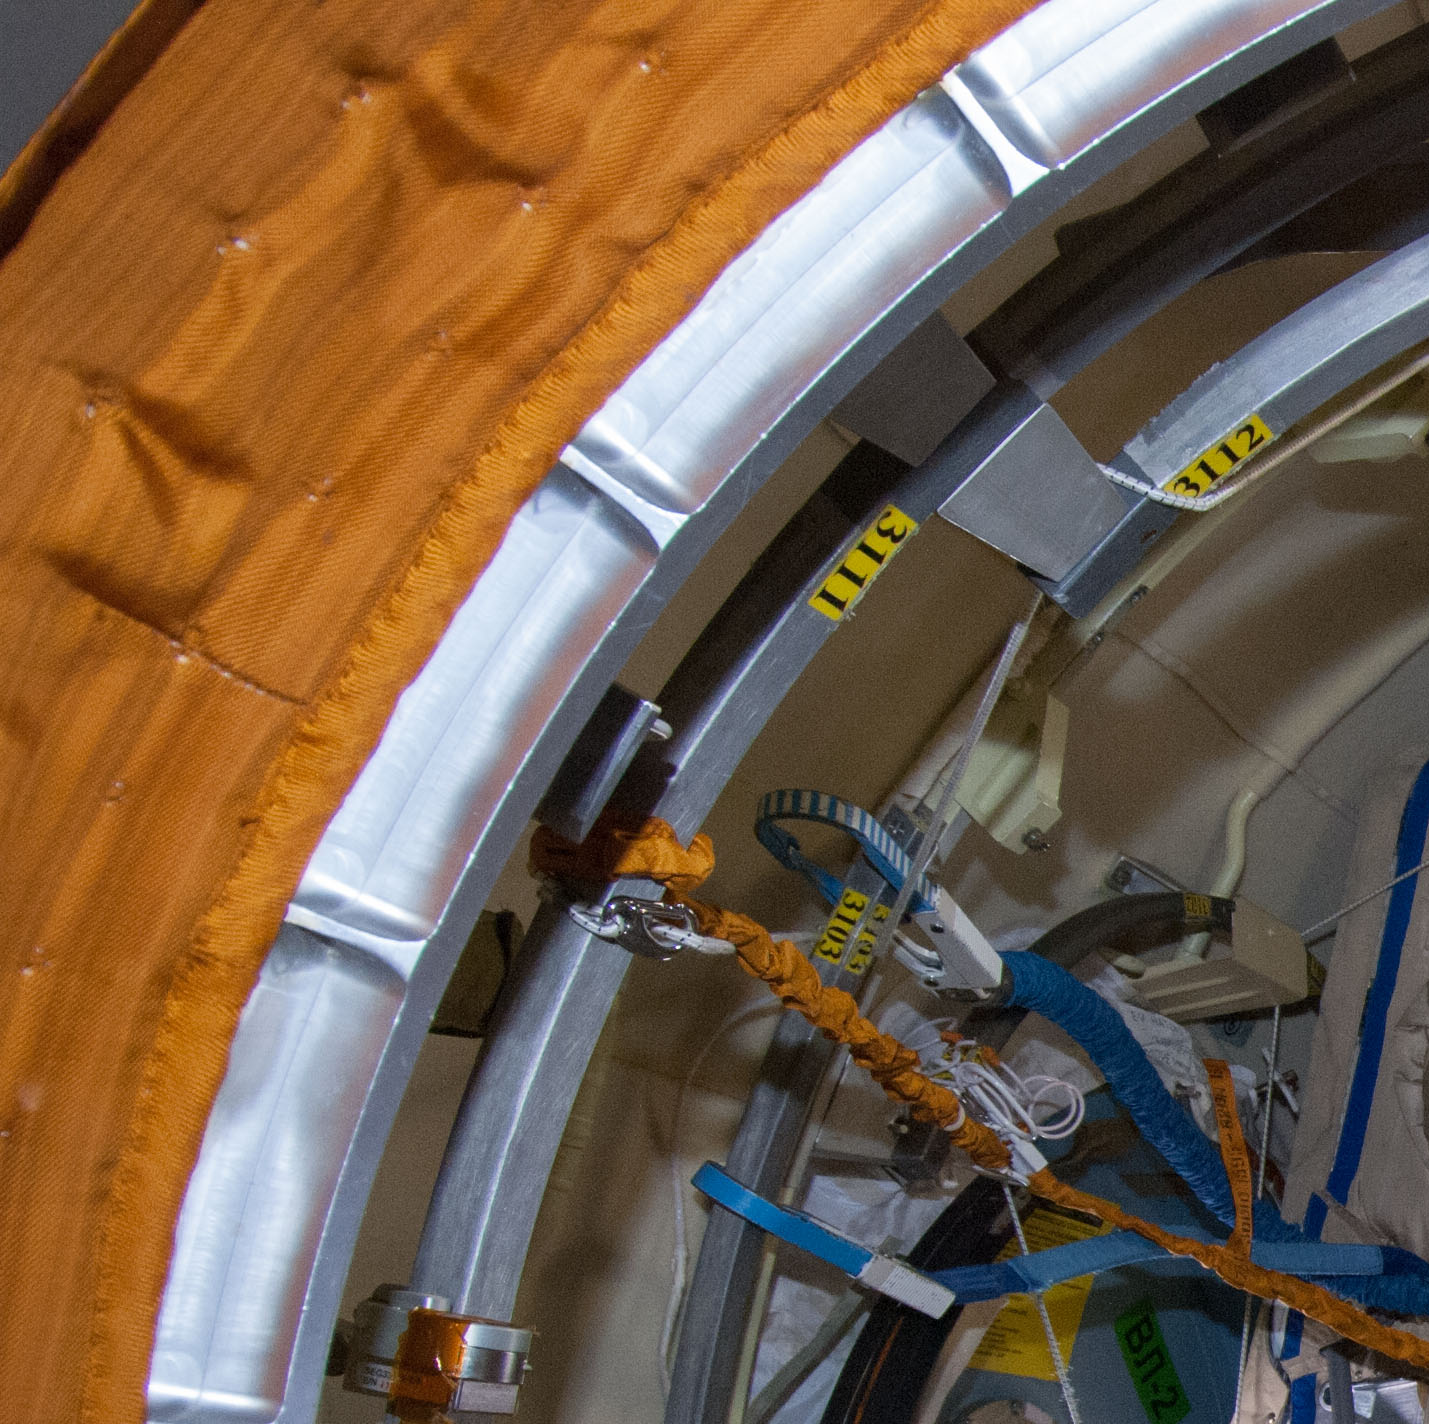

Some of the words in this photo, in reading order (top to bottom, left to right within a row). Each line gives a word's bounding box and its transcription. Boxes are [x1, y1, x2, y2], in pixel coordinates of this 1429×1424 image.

[1174, 424, 1264, 498] 3112
[814, 510, 908, 613] 3111
[821, 892, 865, 958] 3103
